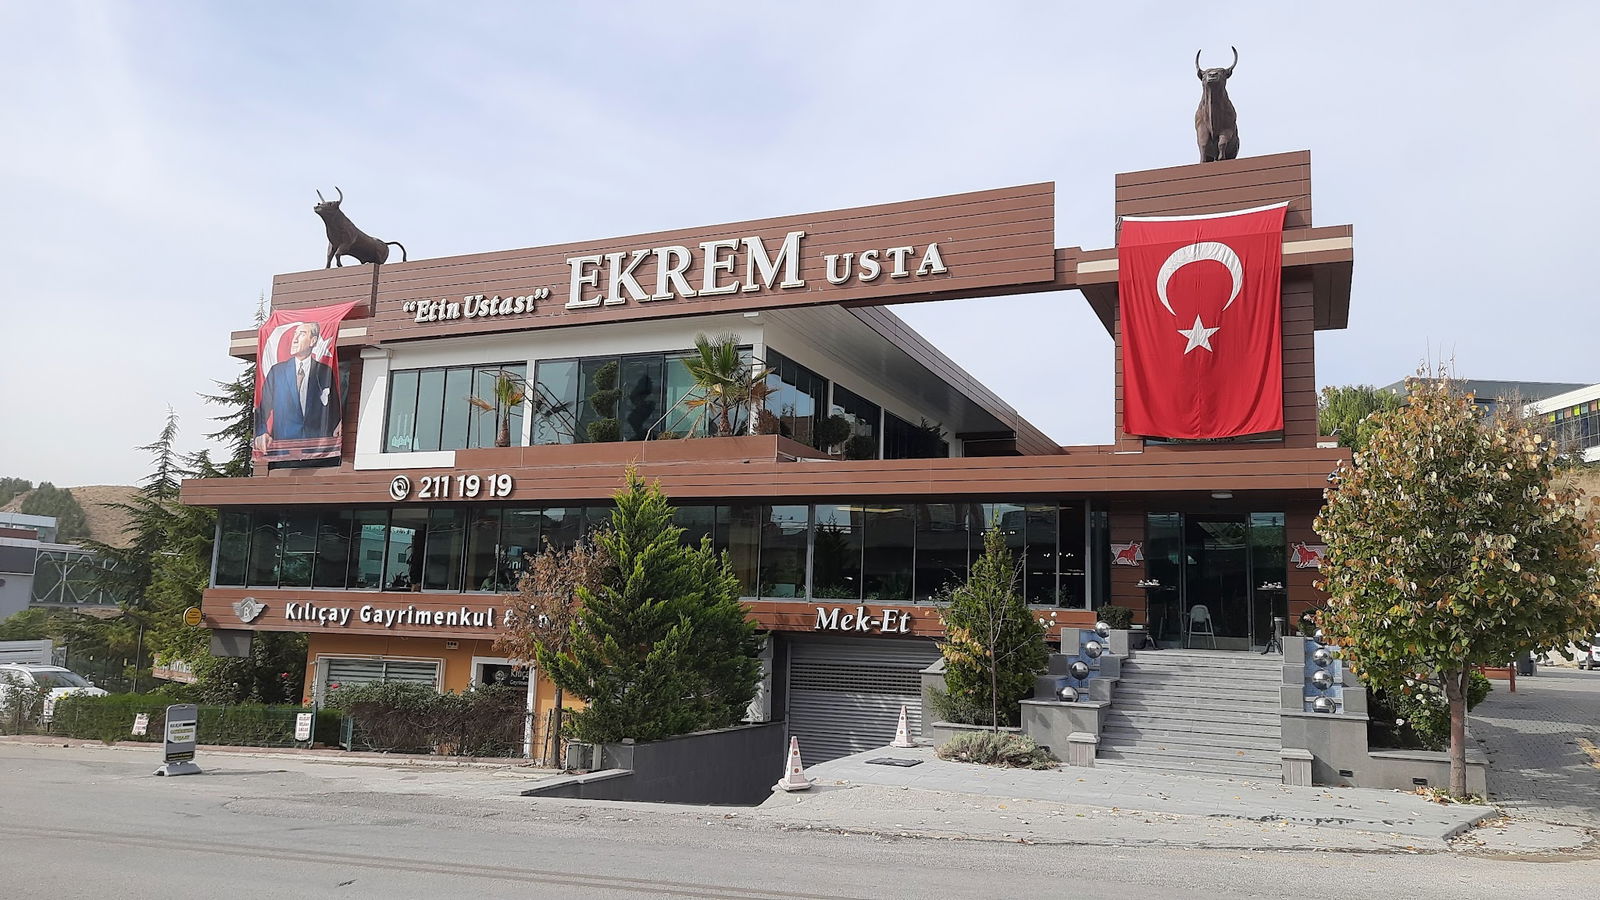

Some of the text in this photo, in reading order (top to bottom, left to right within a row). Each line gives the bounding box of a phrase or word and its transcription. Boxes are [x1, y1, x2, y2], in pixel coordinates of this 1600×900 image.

[565, 230, 805, 310] EKREM
[824, 242, 947, 285] USTA
[418, 473, 513, 498] 211 19 19
[285, 602, 351, 626] Kılıçay
[360, 604, 494, 628] Gayrimenkul
[814, 606, 911, 634] Mek-Et
